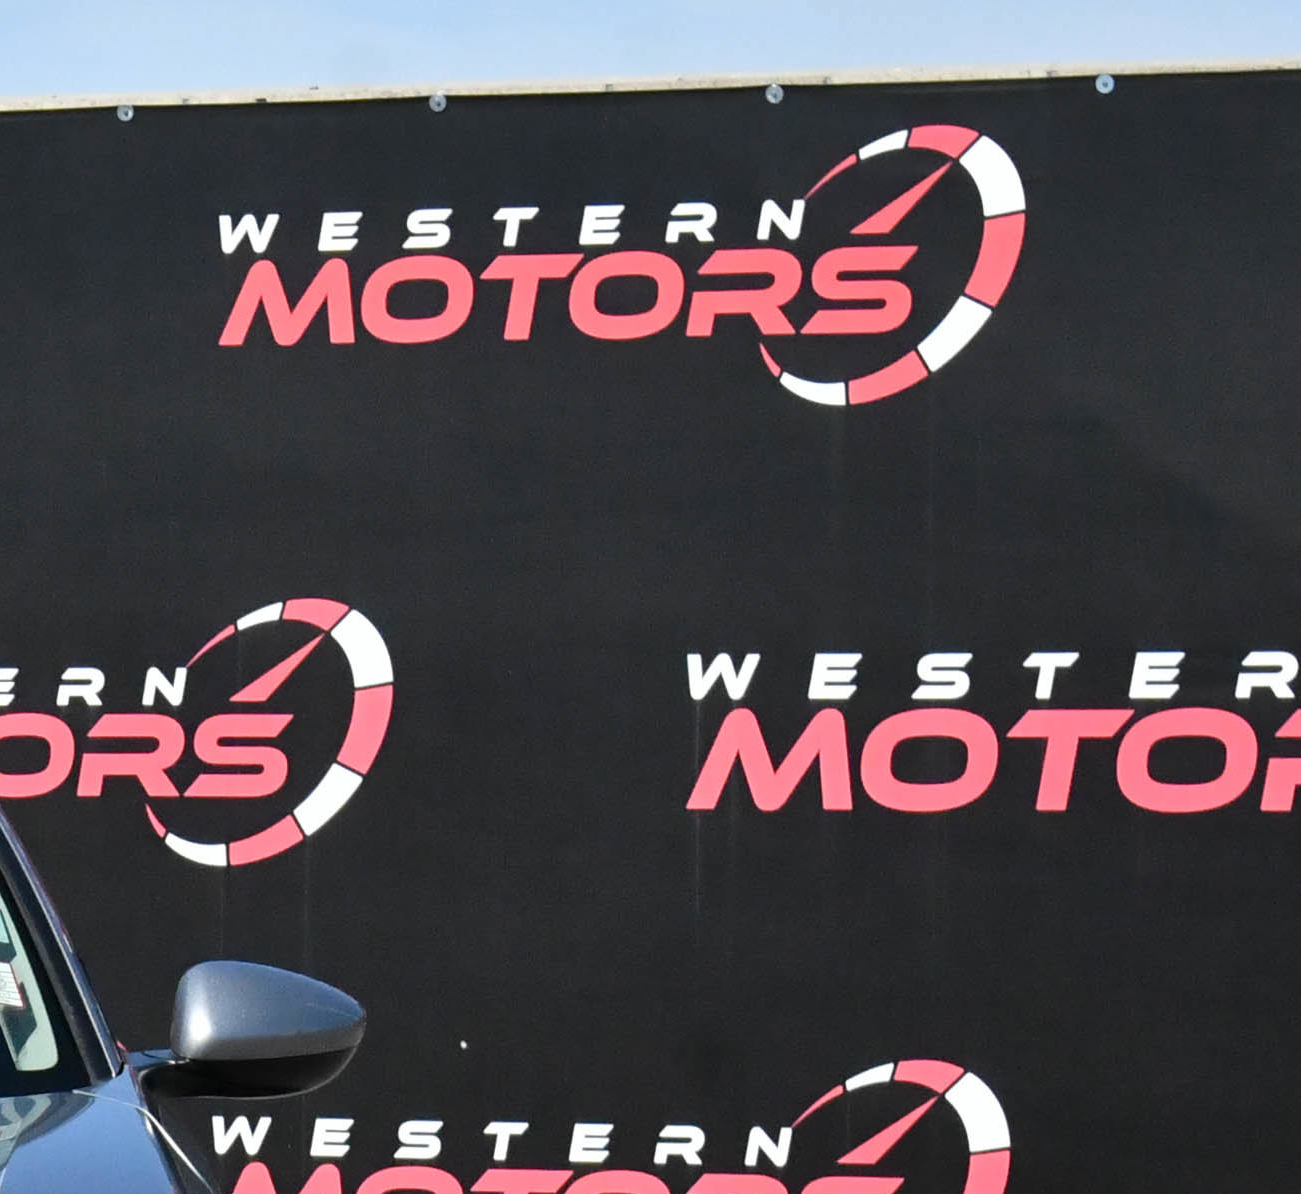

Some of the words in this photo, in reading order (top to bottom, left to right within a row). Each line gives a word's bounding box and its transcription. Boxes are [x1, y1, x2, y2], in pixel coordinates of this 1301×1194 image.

[219, 199, 805, 254] WESTERN
[219, 245, 918, 346] MOTORS
[212, 1116, 792, 1167] WESTERN
